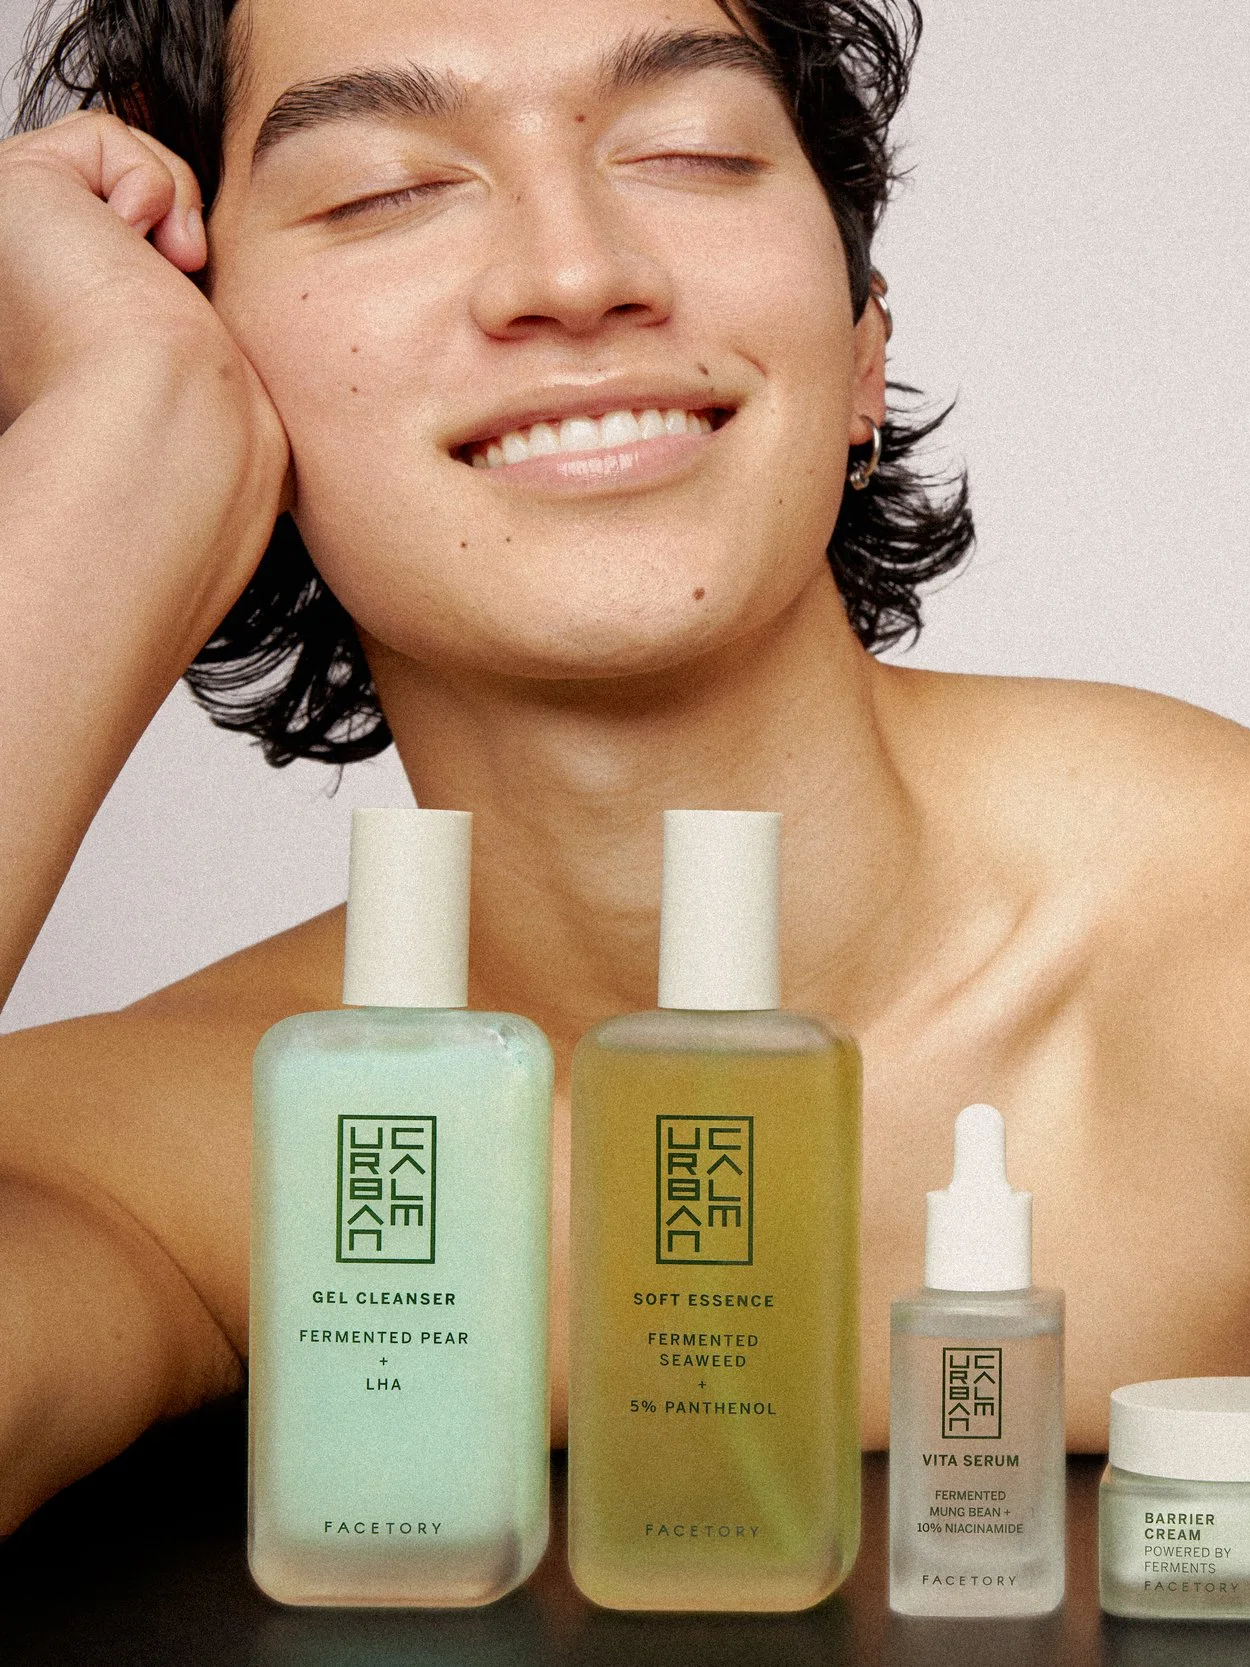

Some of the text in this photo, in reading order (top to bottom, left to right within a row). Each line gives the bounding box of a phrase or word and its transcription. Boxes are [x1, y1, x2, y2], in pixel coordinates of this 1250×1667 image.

[389, 1127, 426, 1226] CALM
[706, 1127, 743, 1228] CALM
[347, 1126, 384, 1251] URBAN
[666, 1127, 702, 1253] URBAN
[312, 1290, 456, 1306] GEL CLEANSER
[633, 1292, 774, 1308] SOFT ESSENCE
[299, 1329, 469, 1345] FERMENTED PEAR
[647, 1332, 759, 1347] FERMENTED
[659, 1353, 747, 1367] SEAWEED
[366, 1378, 402, 1391] LHA
[973, 1355, 995, 1416] CALM
[948, 1355, 970, 1431] URBAN
[630, 1399, 777, 1415] 5% PANTHENOL
[922, 1454, 1020, 1467] VITA SERUM
[935, 1490, 1006, 1501] FERMENTED
[929, 1507, 965, 1517] MUNG
[968, 1507, 1001, 1517] BEAN
[1144, 1512, 1215, 1526] BARRIER
[324, 1520, 443, 1535] FACETORY
[645, 1523, 760, 1539] FACETORY
[917, 1522, 1024, 1534] 10% NIACINAMIDE
[1144, 1528, 1201, 1541] CREAM
[1144, 1546, 1232, 1558] POWERED BY
[1144, 1561, 1216, 1574] FERMENTS
[922, 1574, 1017, 1586] FACETORY
[1144, 1581, 1239, 1593] FACETORY
